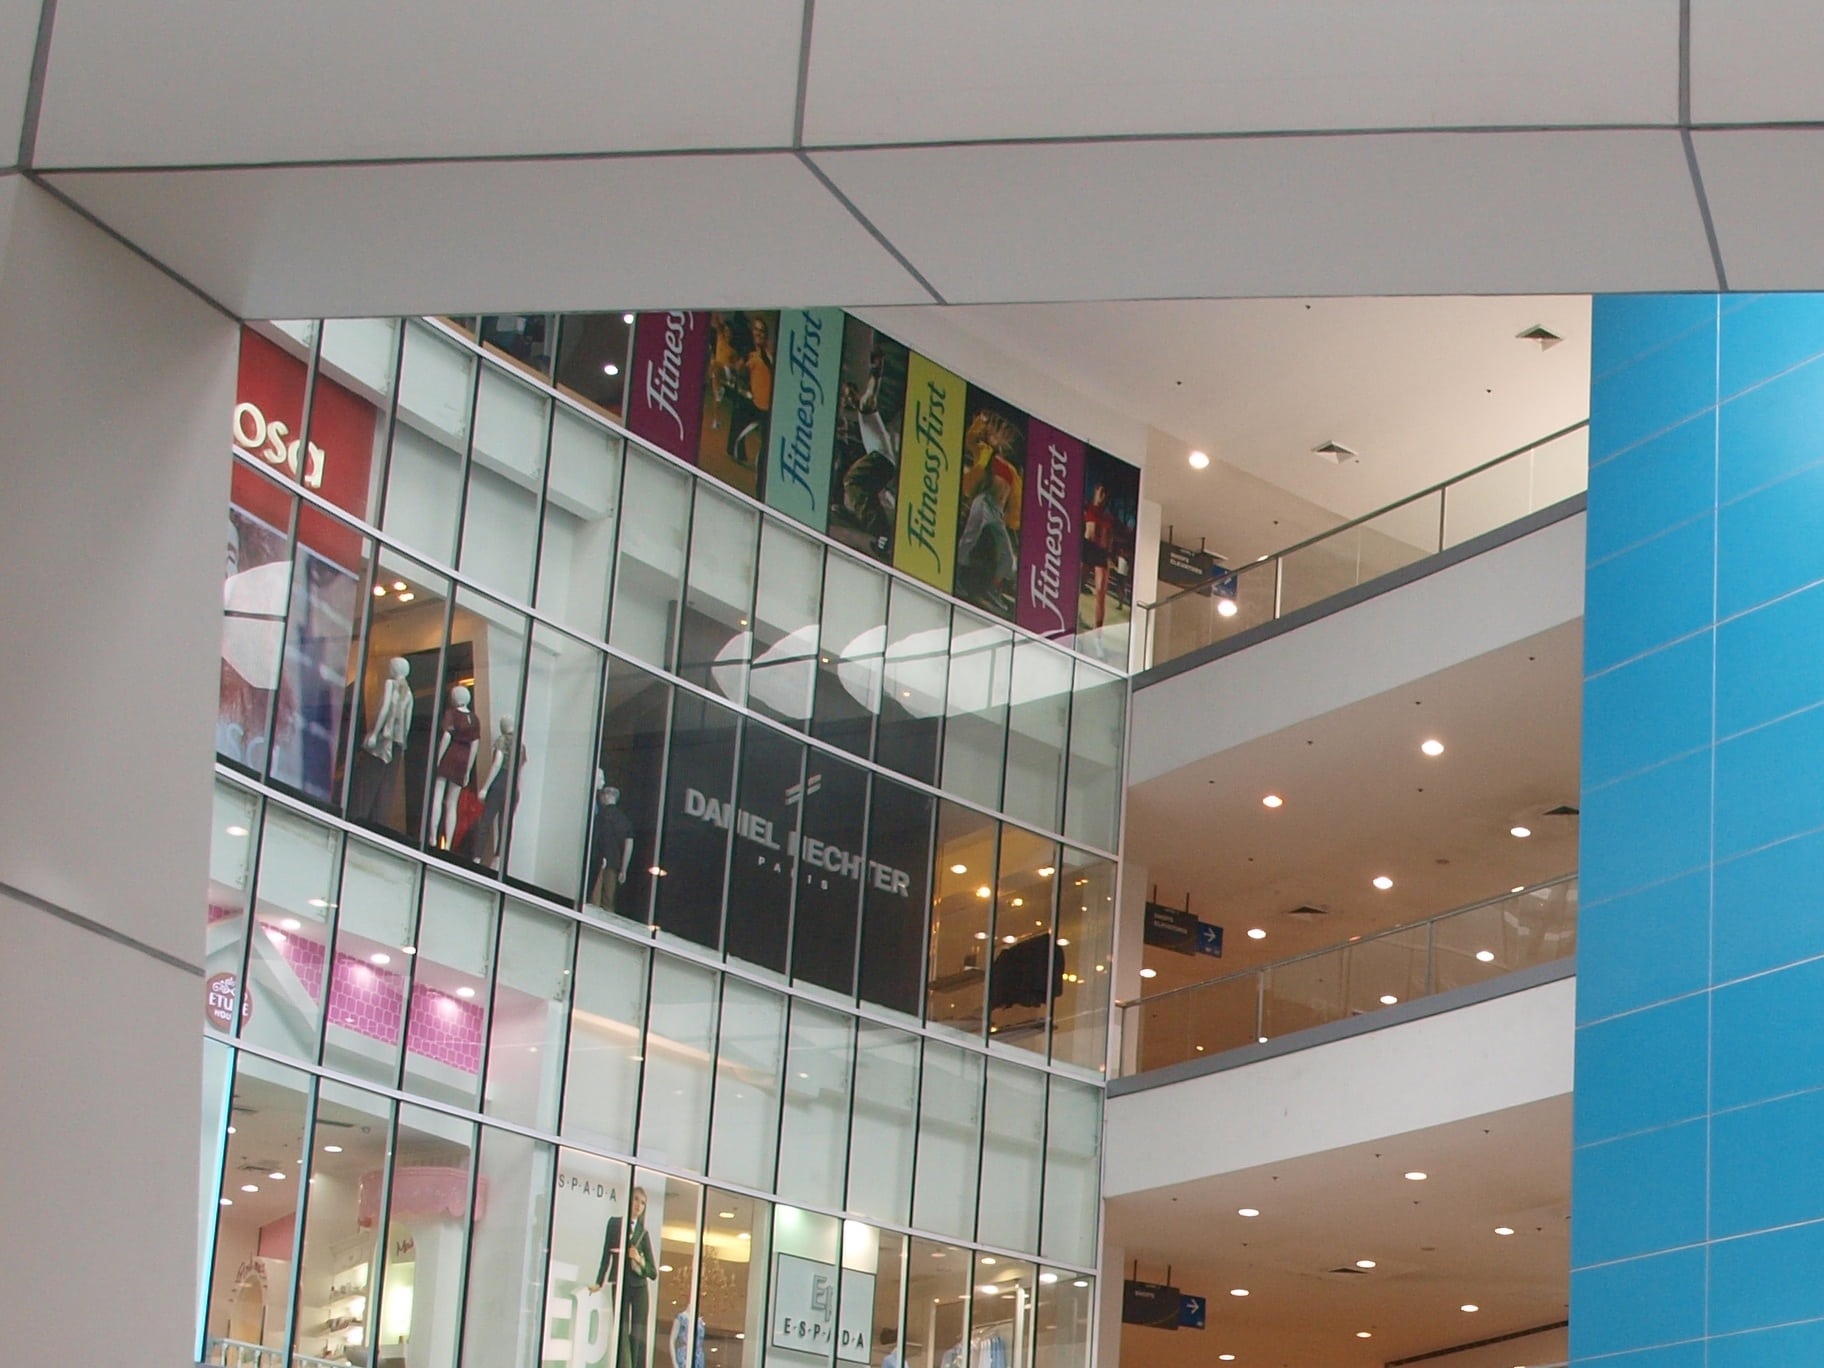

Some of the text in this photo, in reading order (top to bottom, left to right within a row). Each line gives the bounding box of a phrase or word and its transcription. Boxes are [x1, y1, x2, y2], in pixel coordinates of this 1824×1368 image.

[685, 787, 781, 850] DANIEL
[757, 856, 829, 891] PAIS
[786, 830, 911, 898] HECHTER
[208, 992, 249, 1017] ETUE
